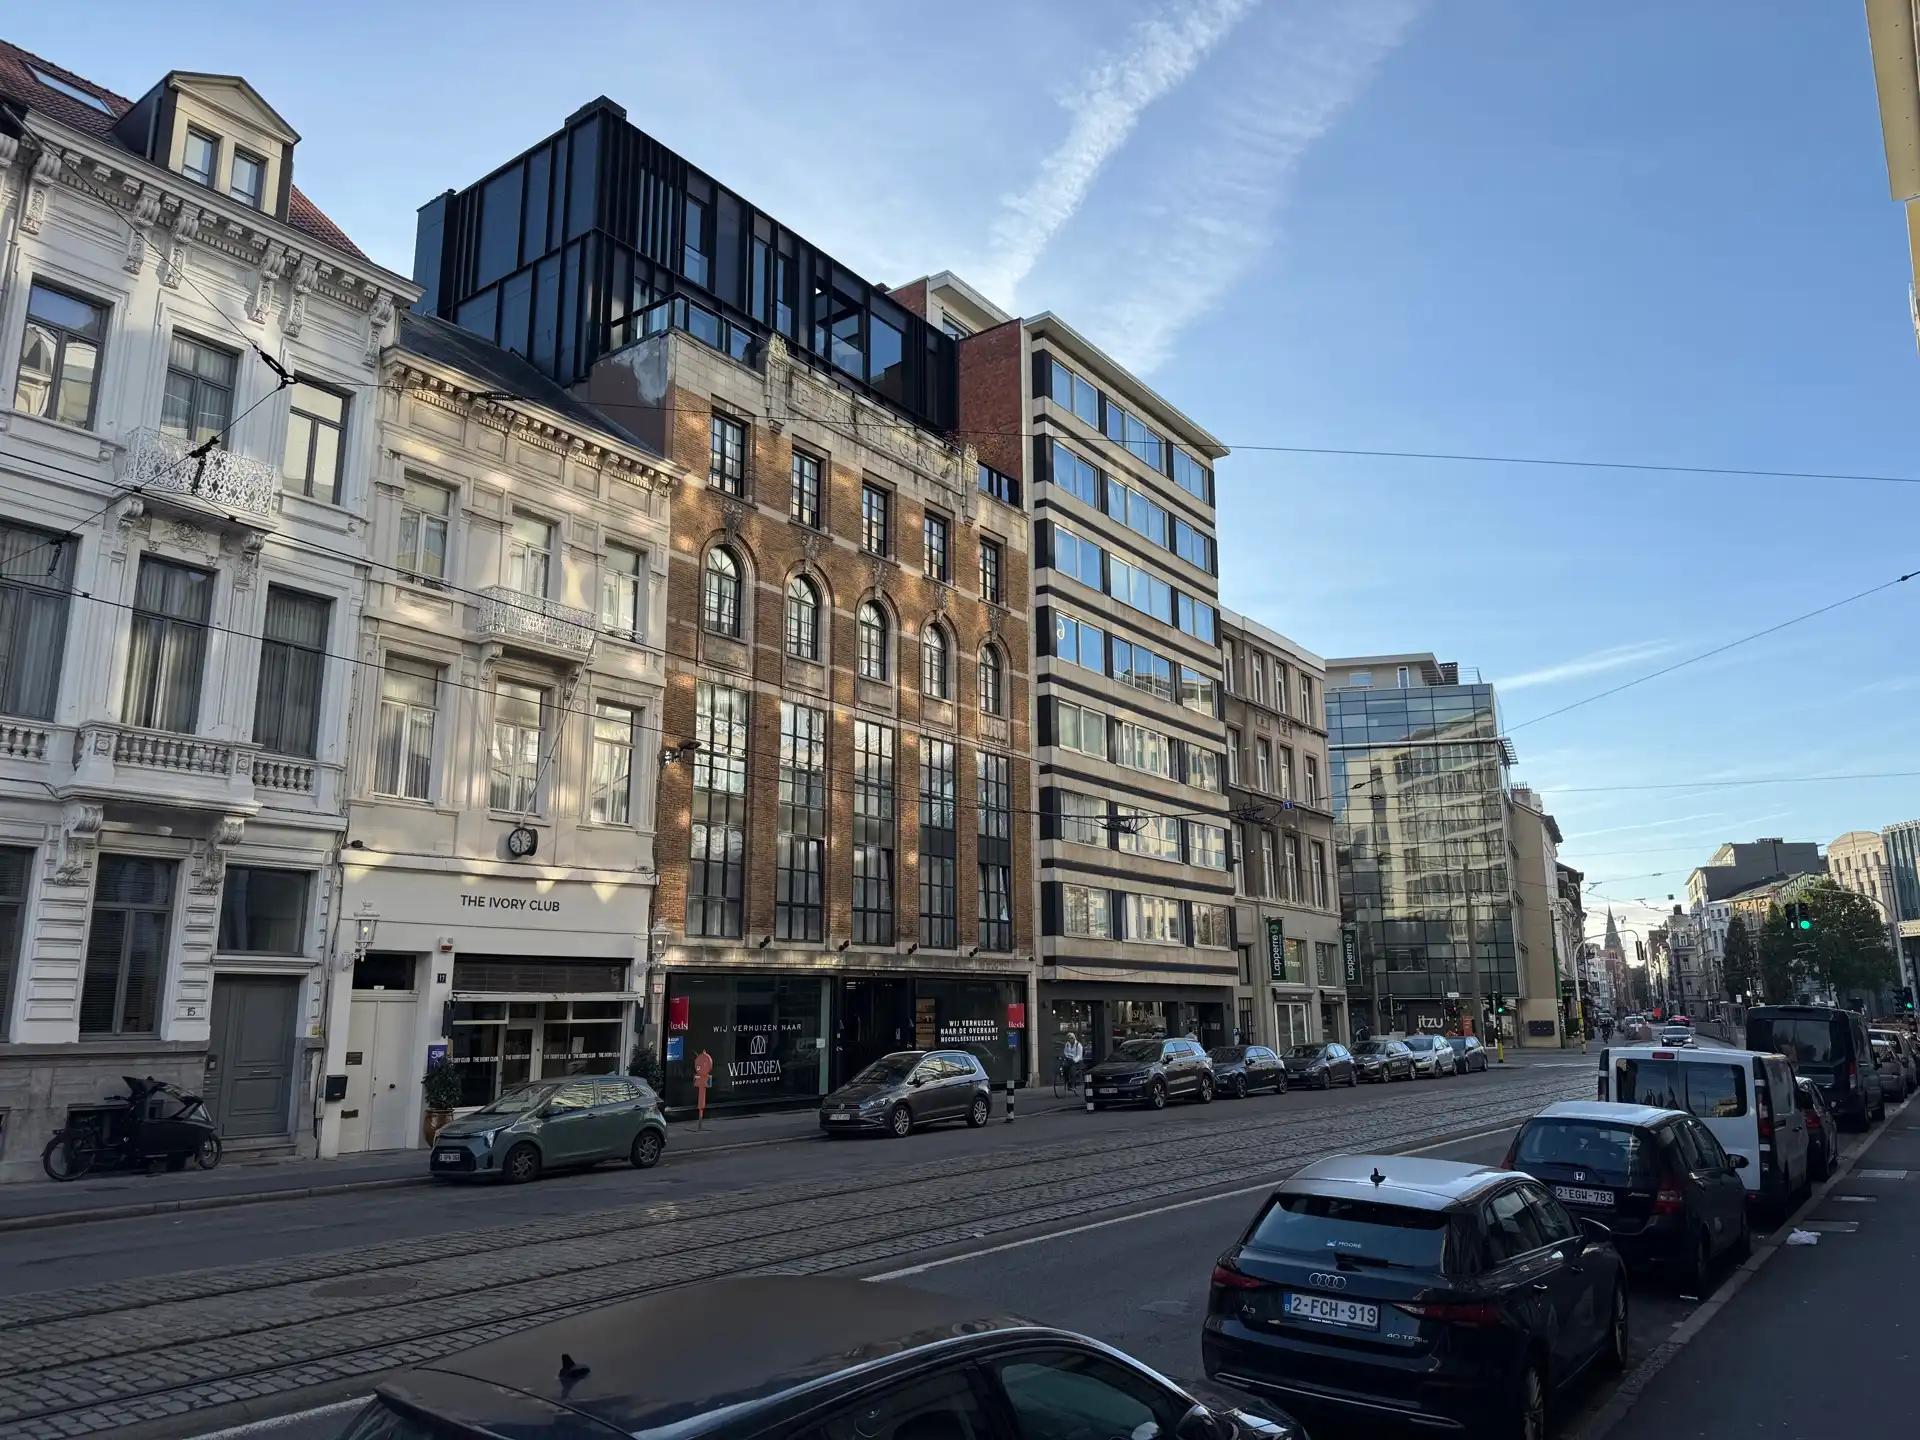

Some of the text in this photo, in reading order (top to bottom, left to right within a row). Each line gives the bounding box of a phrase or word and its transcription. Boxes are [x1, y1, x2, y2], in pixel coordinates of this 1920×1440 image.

[460, 894, 560, 912] THE IVORY CLUB
[1271, 934, 1282, 976] Lapperre
[1346, 942, 1356, 981] Lapperre
[187, 1006, 196, 1017] 15
[961, 1019, 995, 1027] VERHUIZEN
[1417, 1014, 1444, 1029] itzu
[712, 1023, 802, 1033] WIJ VERHUIZEN NAAR
[940, 1027, 957, 1035] NAAR
[731, 1078, 759, 1087] SHOPPING
[1338, 1241, 1362, 1249] MOORE
[1241, 1304, 1256, 1314] A3
[1292, 1296, 1377, 1324] 2-FCH-919
